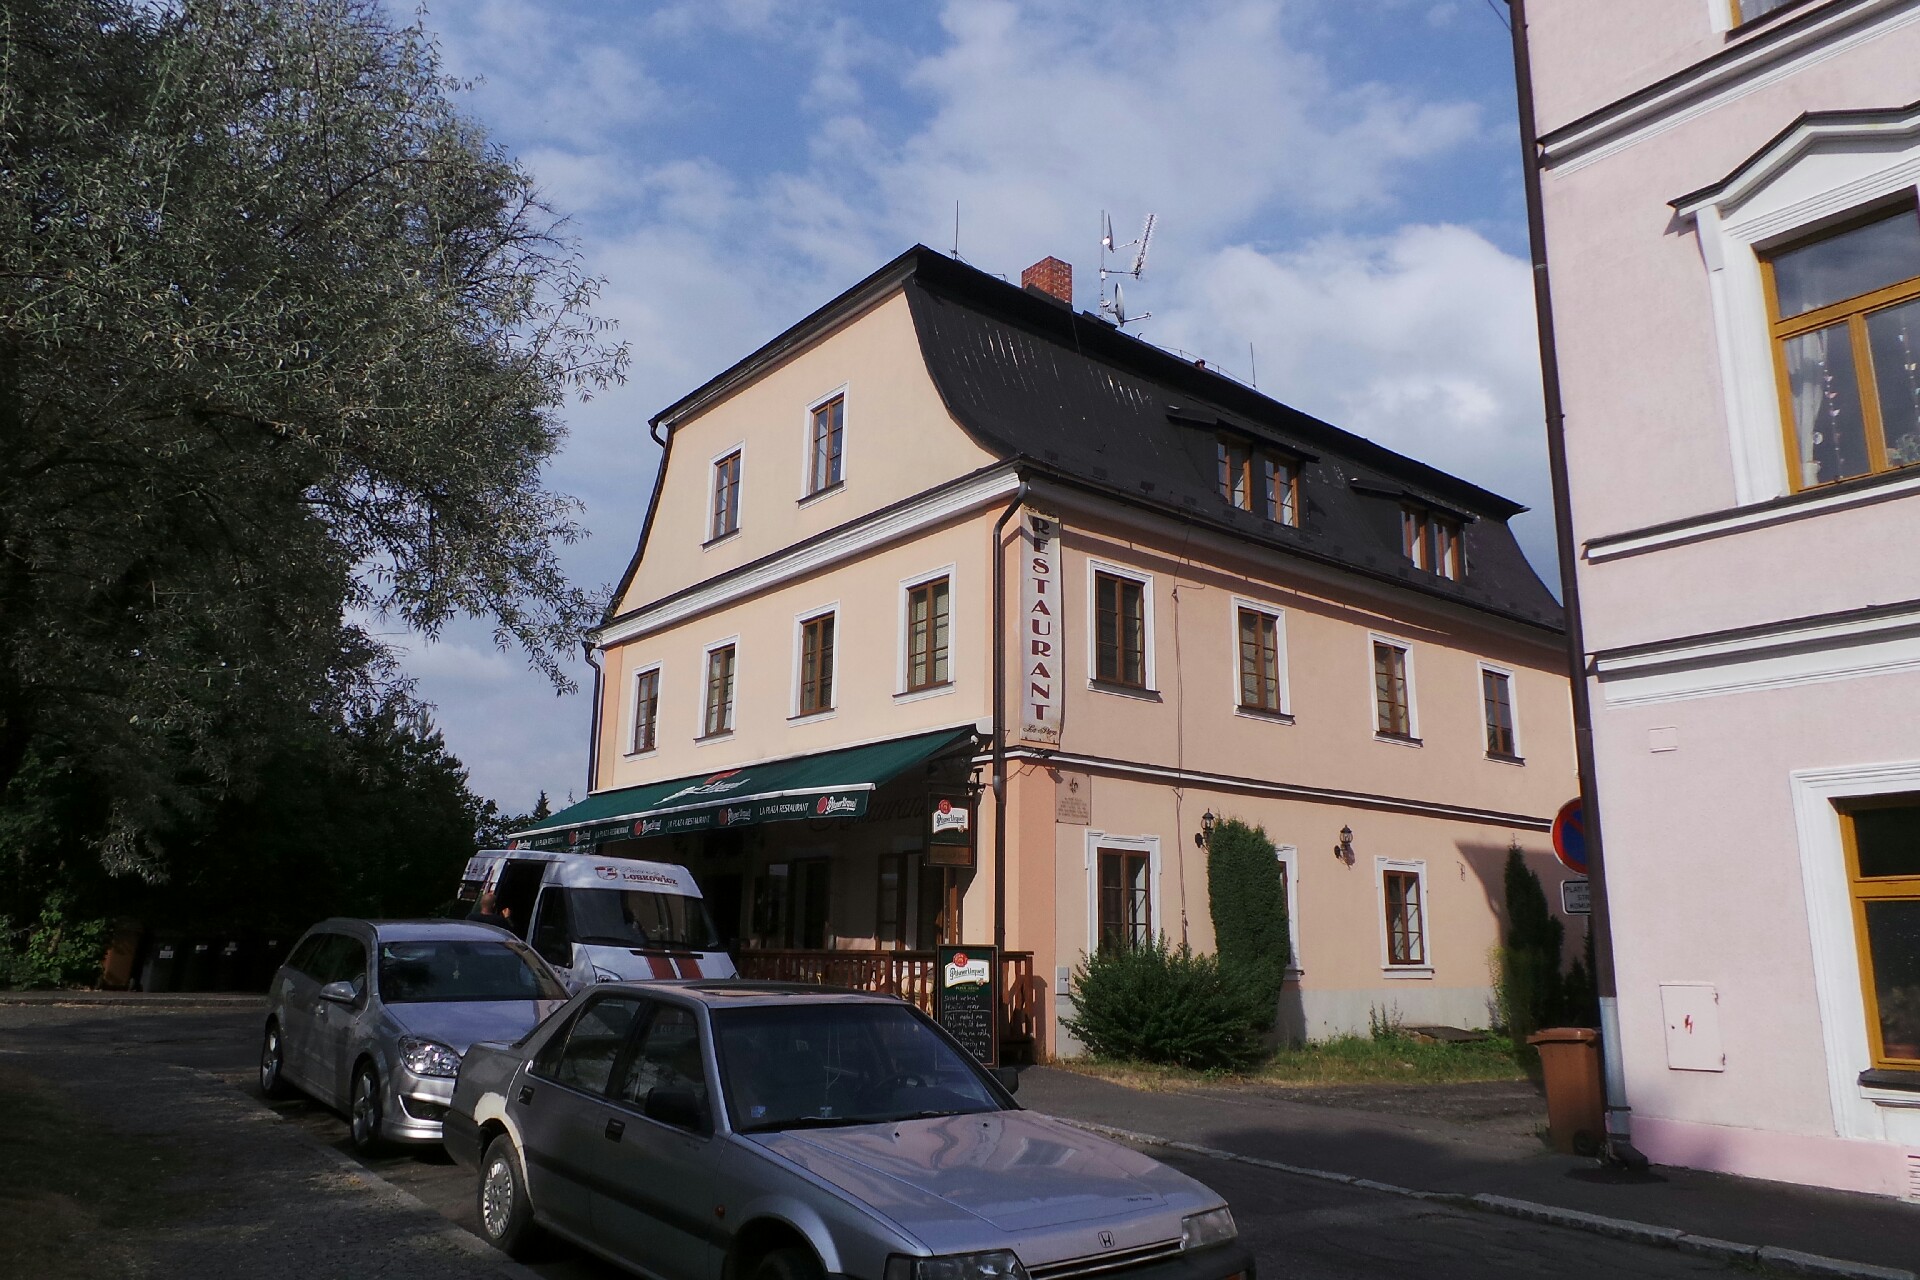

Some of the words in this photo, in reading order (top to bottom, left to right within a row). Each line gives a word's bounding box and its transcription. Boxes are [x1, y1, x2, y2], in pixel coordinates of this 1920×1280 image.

[1030, 516, 1052, 721] RESTAURANT
[779, 802, 809, 813] RESTAURANT
[622, 873, 678, 885] LOBKOWICZ
[949, 967, 969, 980] Pilsner
[967, 967, 985, 977] Urquell
